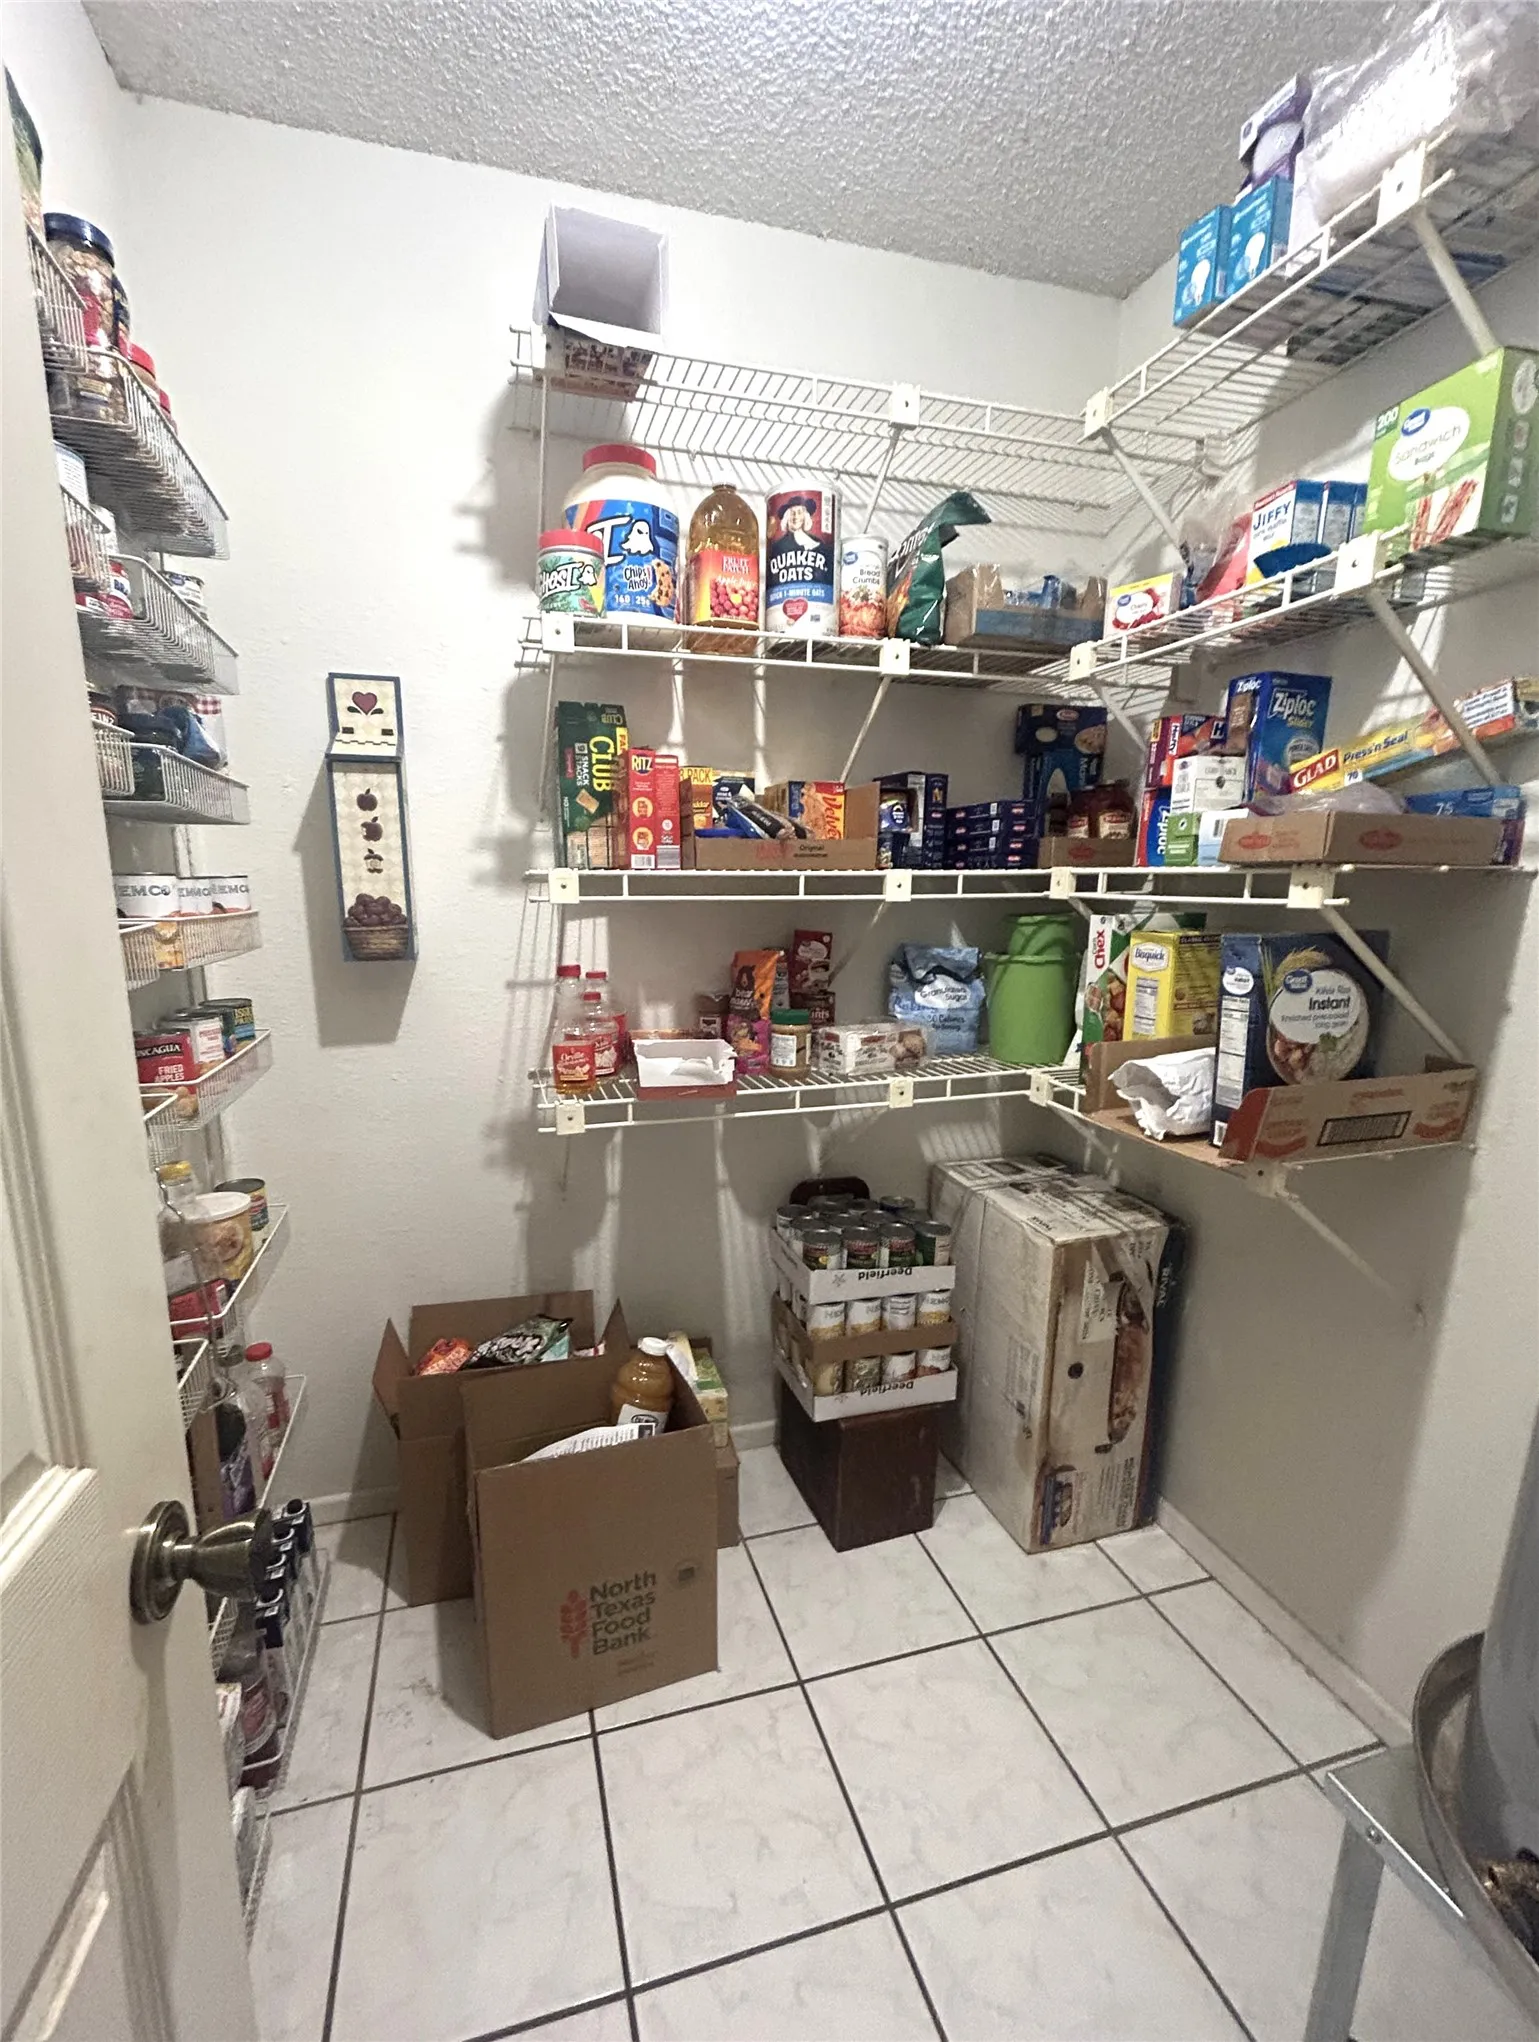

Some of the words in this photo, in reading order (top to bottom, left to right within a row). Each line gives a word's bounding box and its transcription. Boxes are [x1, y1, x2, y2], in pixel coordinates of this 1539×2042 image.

[1378, 406, 1399, 428] 200
[1253, 500, 1291, 530] JIFFY
[624, 566, 647, 581] Chips
[770, 549, 826, 574] QUAKER
[779, 567, 814, 582] OATS
[541, 562, 584, 600] HOST
[1273, 692, 1317, 719] Ziploc
[1383, 730, 1408, 749] Seal
[581, 756, 590, 786] SNACK
[589, 735, 615, 792] CLUB
[632, 755, 653, 771] RITZ
[687, 767, 712, 783] PACK
[1293, 754, 1337, 788] GLAD
[1094, 929, 1106, 969] Chex
[1134, 947, 1165, 962] Bisquick
[1309, 996, 1351, 1011] Instant
[158, 1064, 184, 1075] FRIED
[857, 1267, 913, 1281] Deerfield
[1157, 1268, 1169, 1308] RIVAL
[859, 1381, 914, 1397] Deerfield
[589, 1570, 657, 1602] North
[590, 1591, 657, 1618] Texas
[592, 1607, 651, 1637] Food
[592, 1626, 651, 1655] Bank
